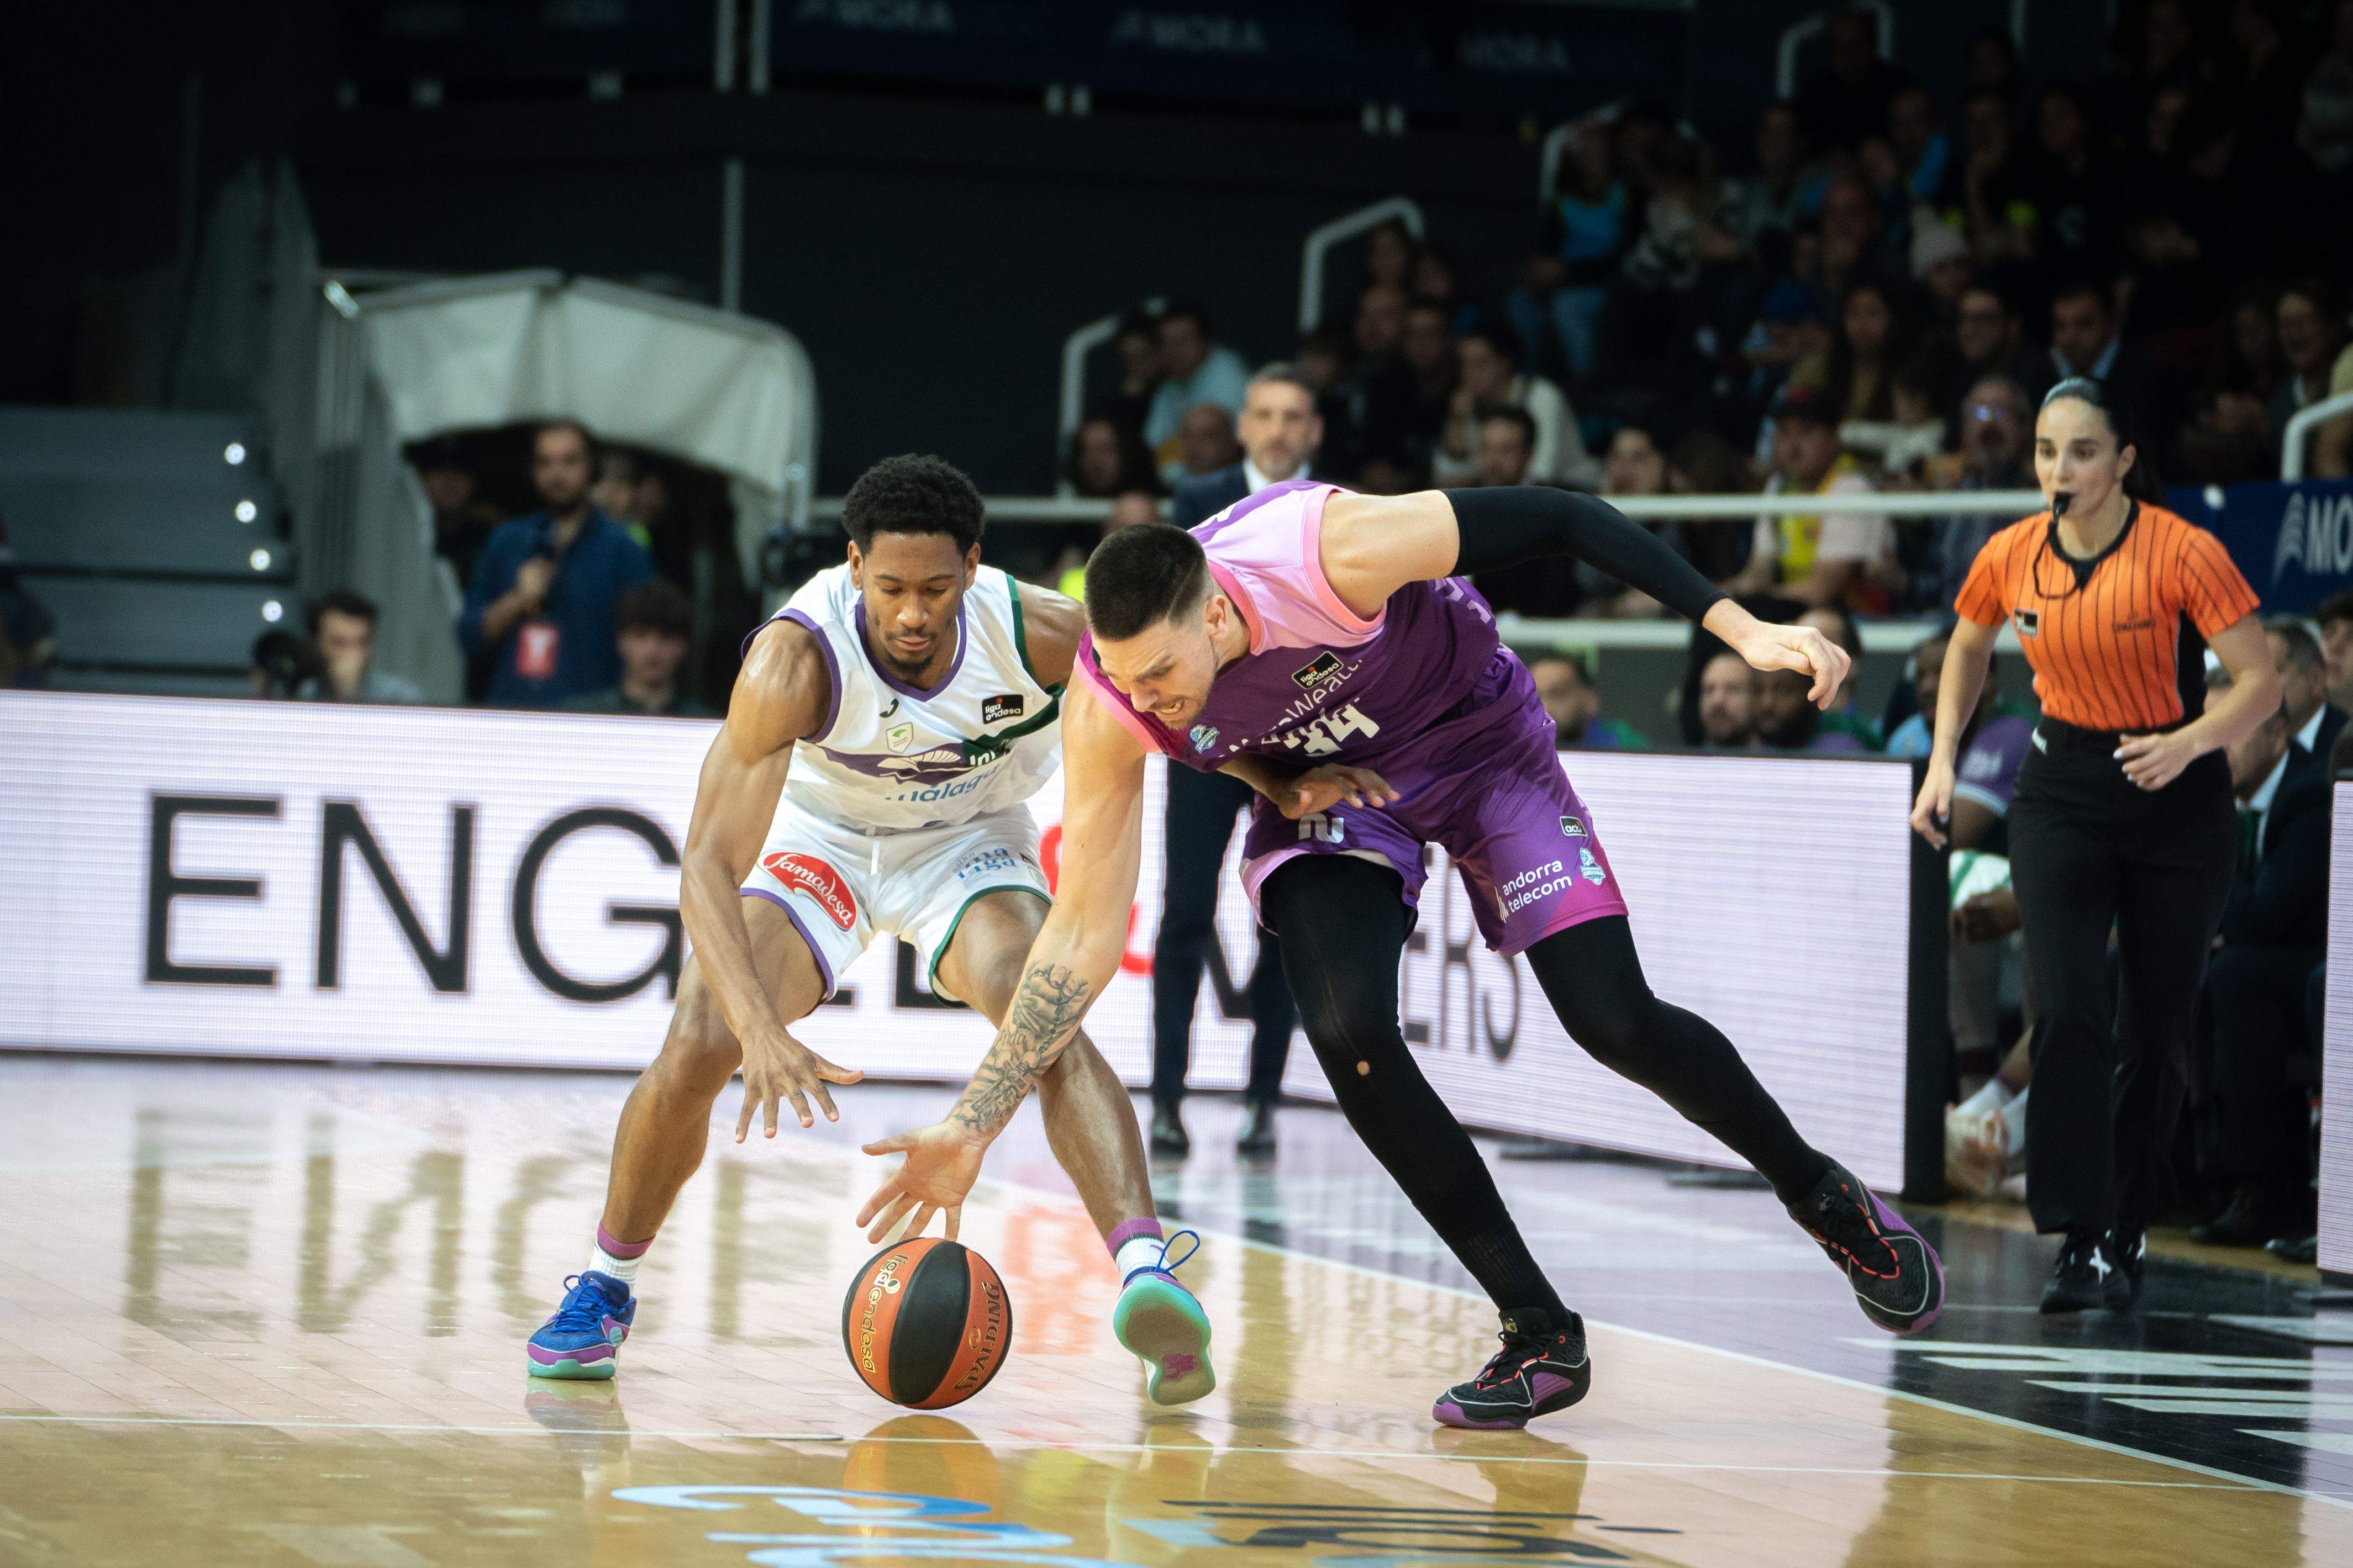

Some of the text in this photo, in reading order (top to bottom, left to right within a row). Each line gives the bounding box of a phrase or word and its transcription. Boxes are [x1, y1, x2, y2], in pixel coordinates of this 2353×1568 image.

[1306, 663, 1339, 686] endesa
[985, 703, 1001, 714] liga
[986, 708, 1021, 721] endesa
[1565, 823, 1582, 833] acb
[765, 853, 853, 925] famadesa
[1502, 860, 1563, 896] andorra
[1508, 875, 1572, 913] telecom
[144, 789, 970, 1010] ENG
[861, 1253, 909, 1373] liga endesa
[954, 1281, 1002, 1391] SPALDING
